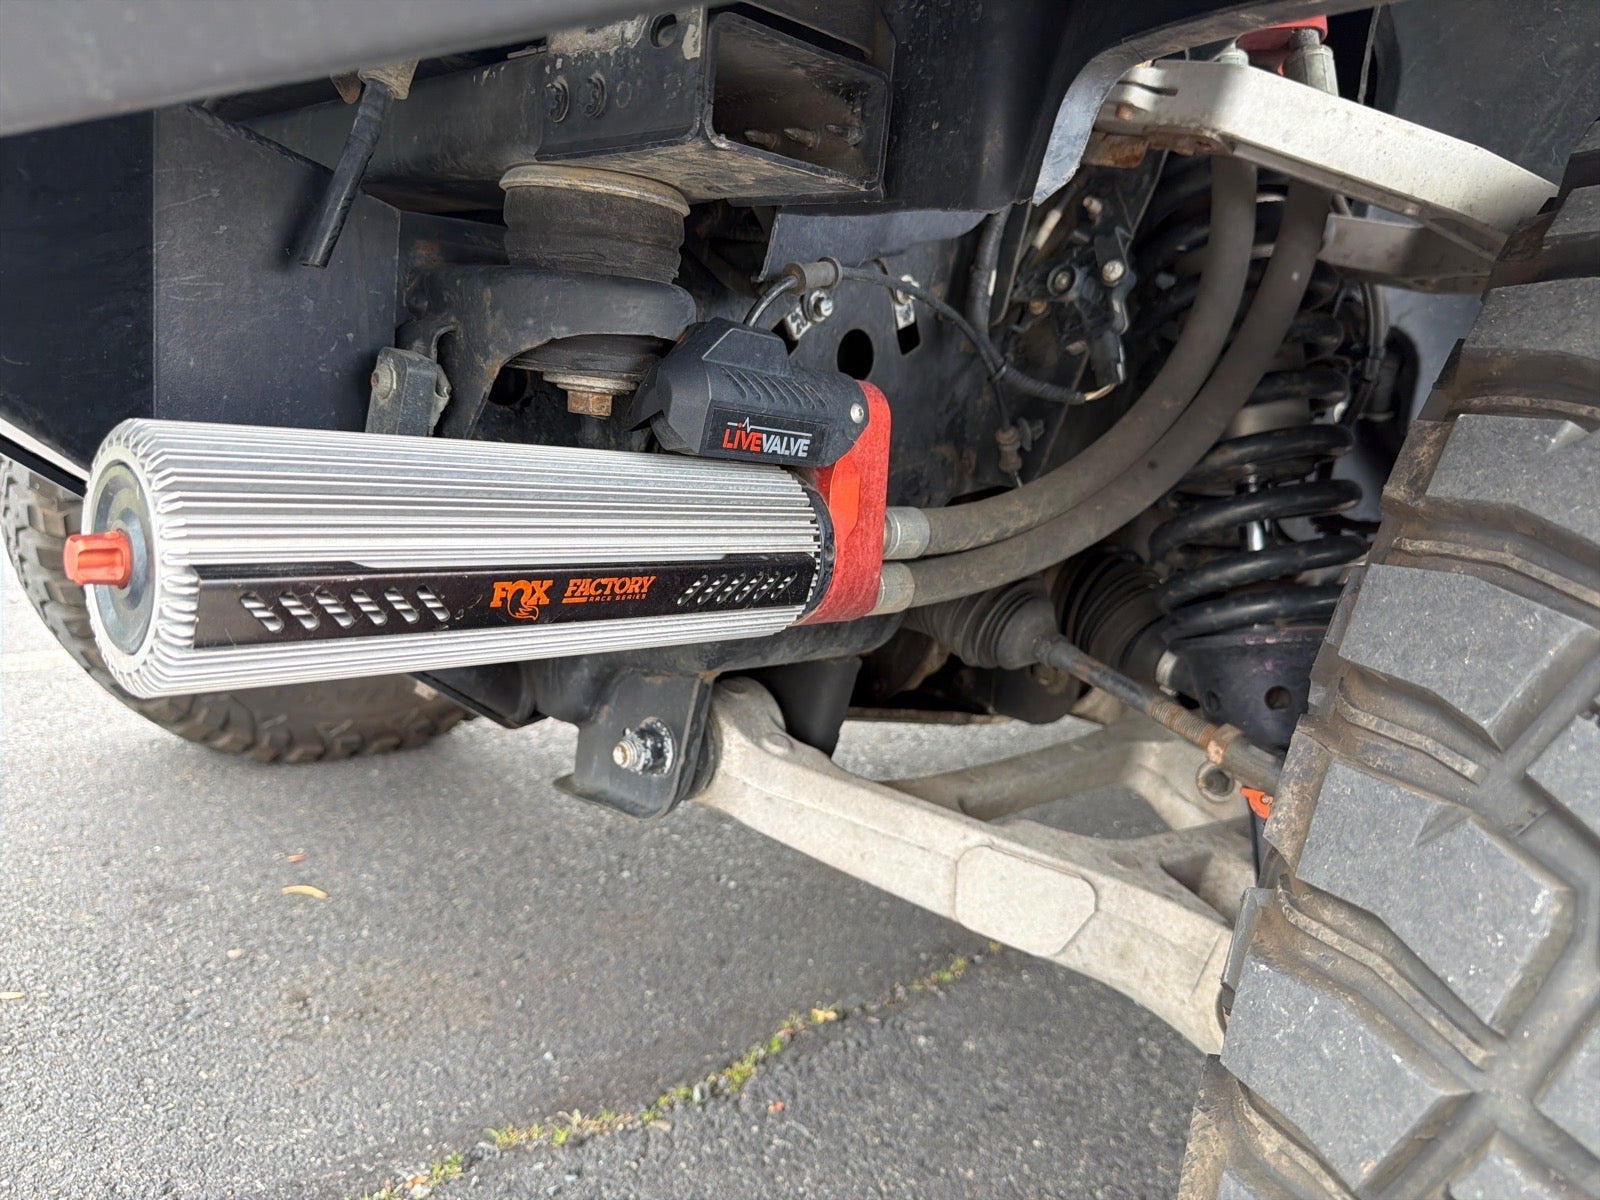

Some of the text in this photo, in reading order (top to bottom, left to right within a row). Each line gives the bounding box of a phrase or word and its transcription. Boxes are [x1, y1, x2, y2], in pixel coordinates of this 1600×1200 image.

[490, 575, 657, 620] FOX FACTORY
[588, 593, 647, 603] RACE SERIES
